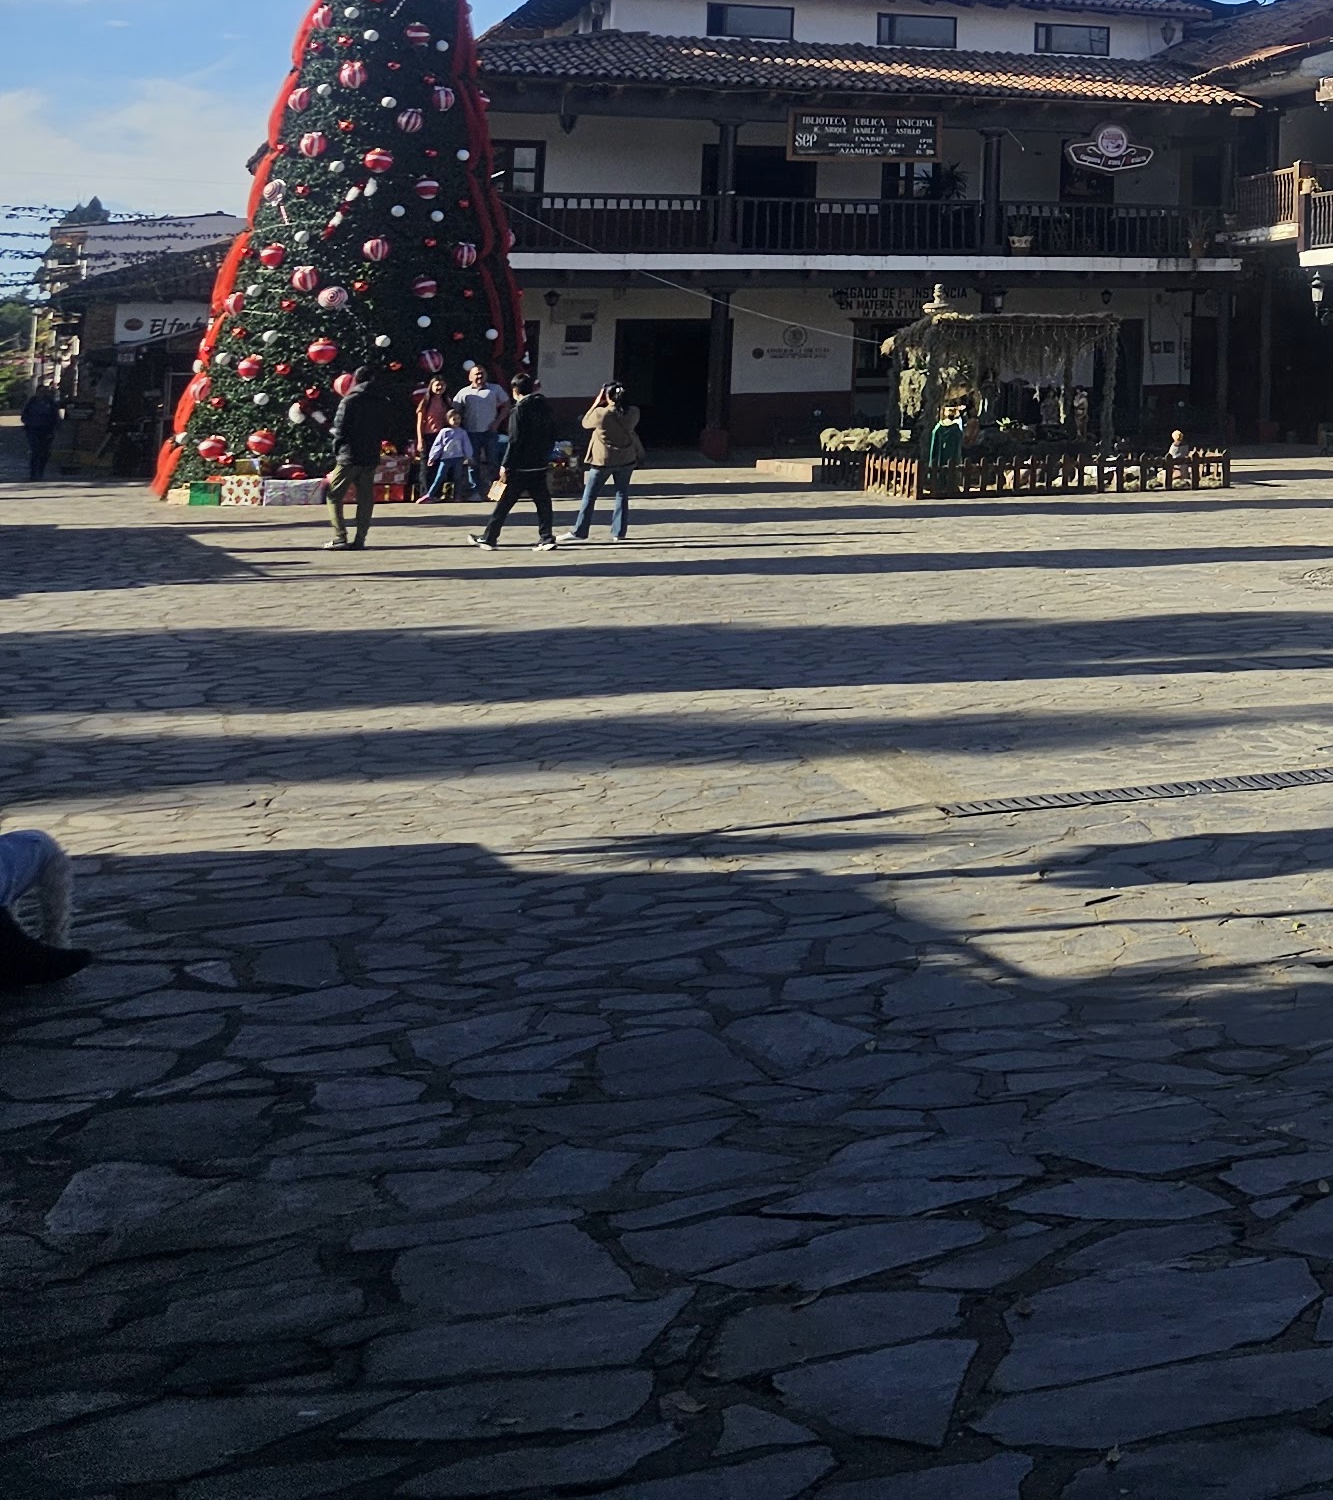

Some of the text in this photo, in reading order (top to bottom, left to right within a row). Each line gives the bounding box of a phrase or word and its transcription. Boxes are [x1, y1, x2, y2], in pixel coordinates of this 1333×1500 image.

[798, 116, 935, 128] IBLIOTECA UBLICA UNICIPAL
[892, 127, 922, 135] ASTILLO
[829, 287, 879, 299] GADO
[911, 287, 968, 299] INSNCIA
[863, 309, 923, 318] MAZAMIT
